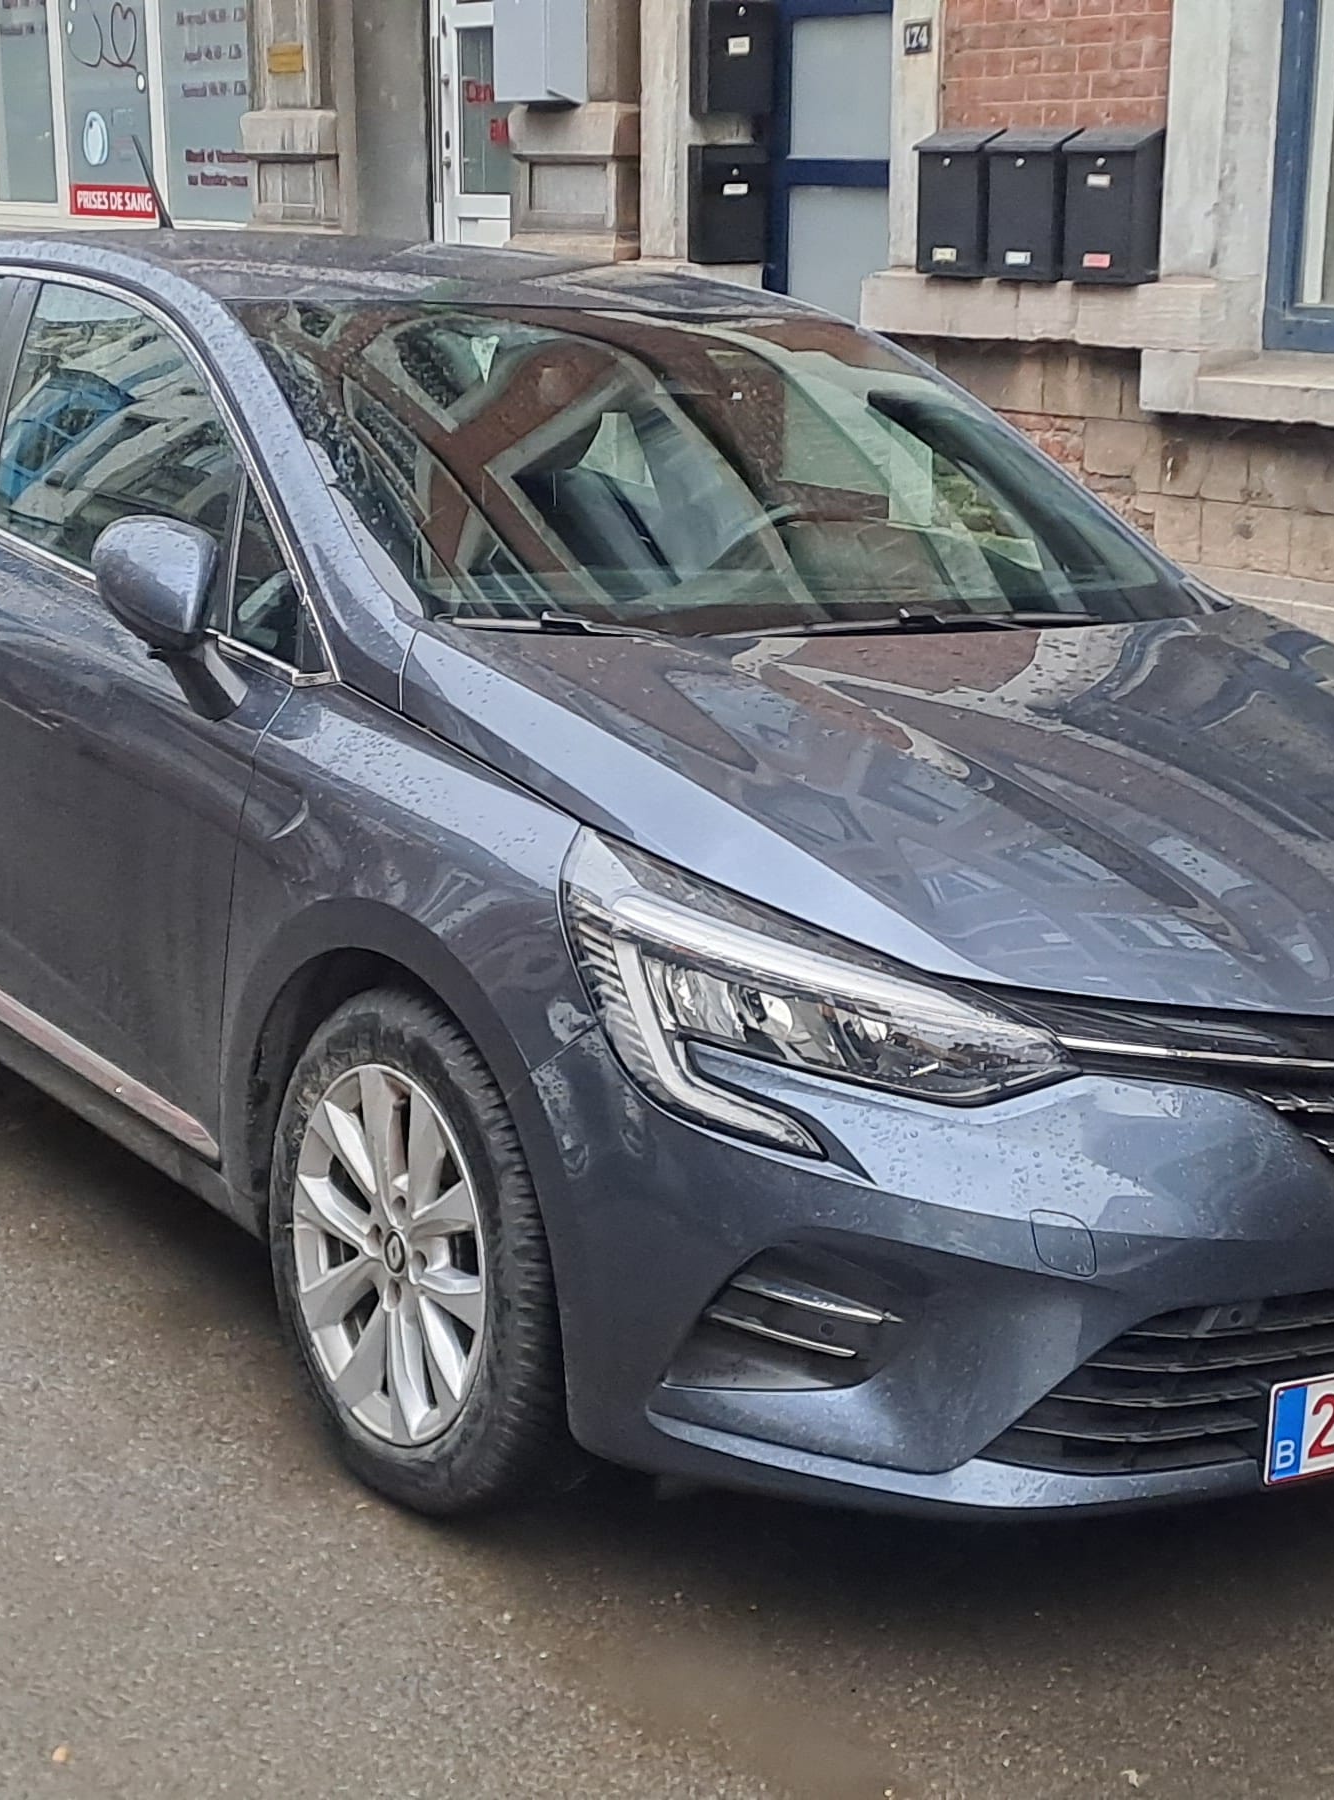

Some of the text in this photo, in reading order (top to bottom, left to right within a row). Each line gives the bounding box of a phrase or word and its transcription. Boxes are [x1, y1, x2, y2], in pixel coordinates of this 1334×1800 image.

[906, 25, 928, 49] 174
[76, 190, 153, 212] PRISES DE SANG
[1275, 1439, 1295, 1470] B
